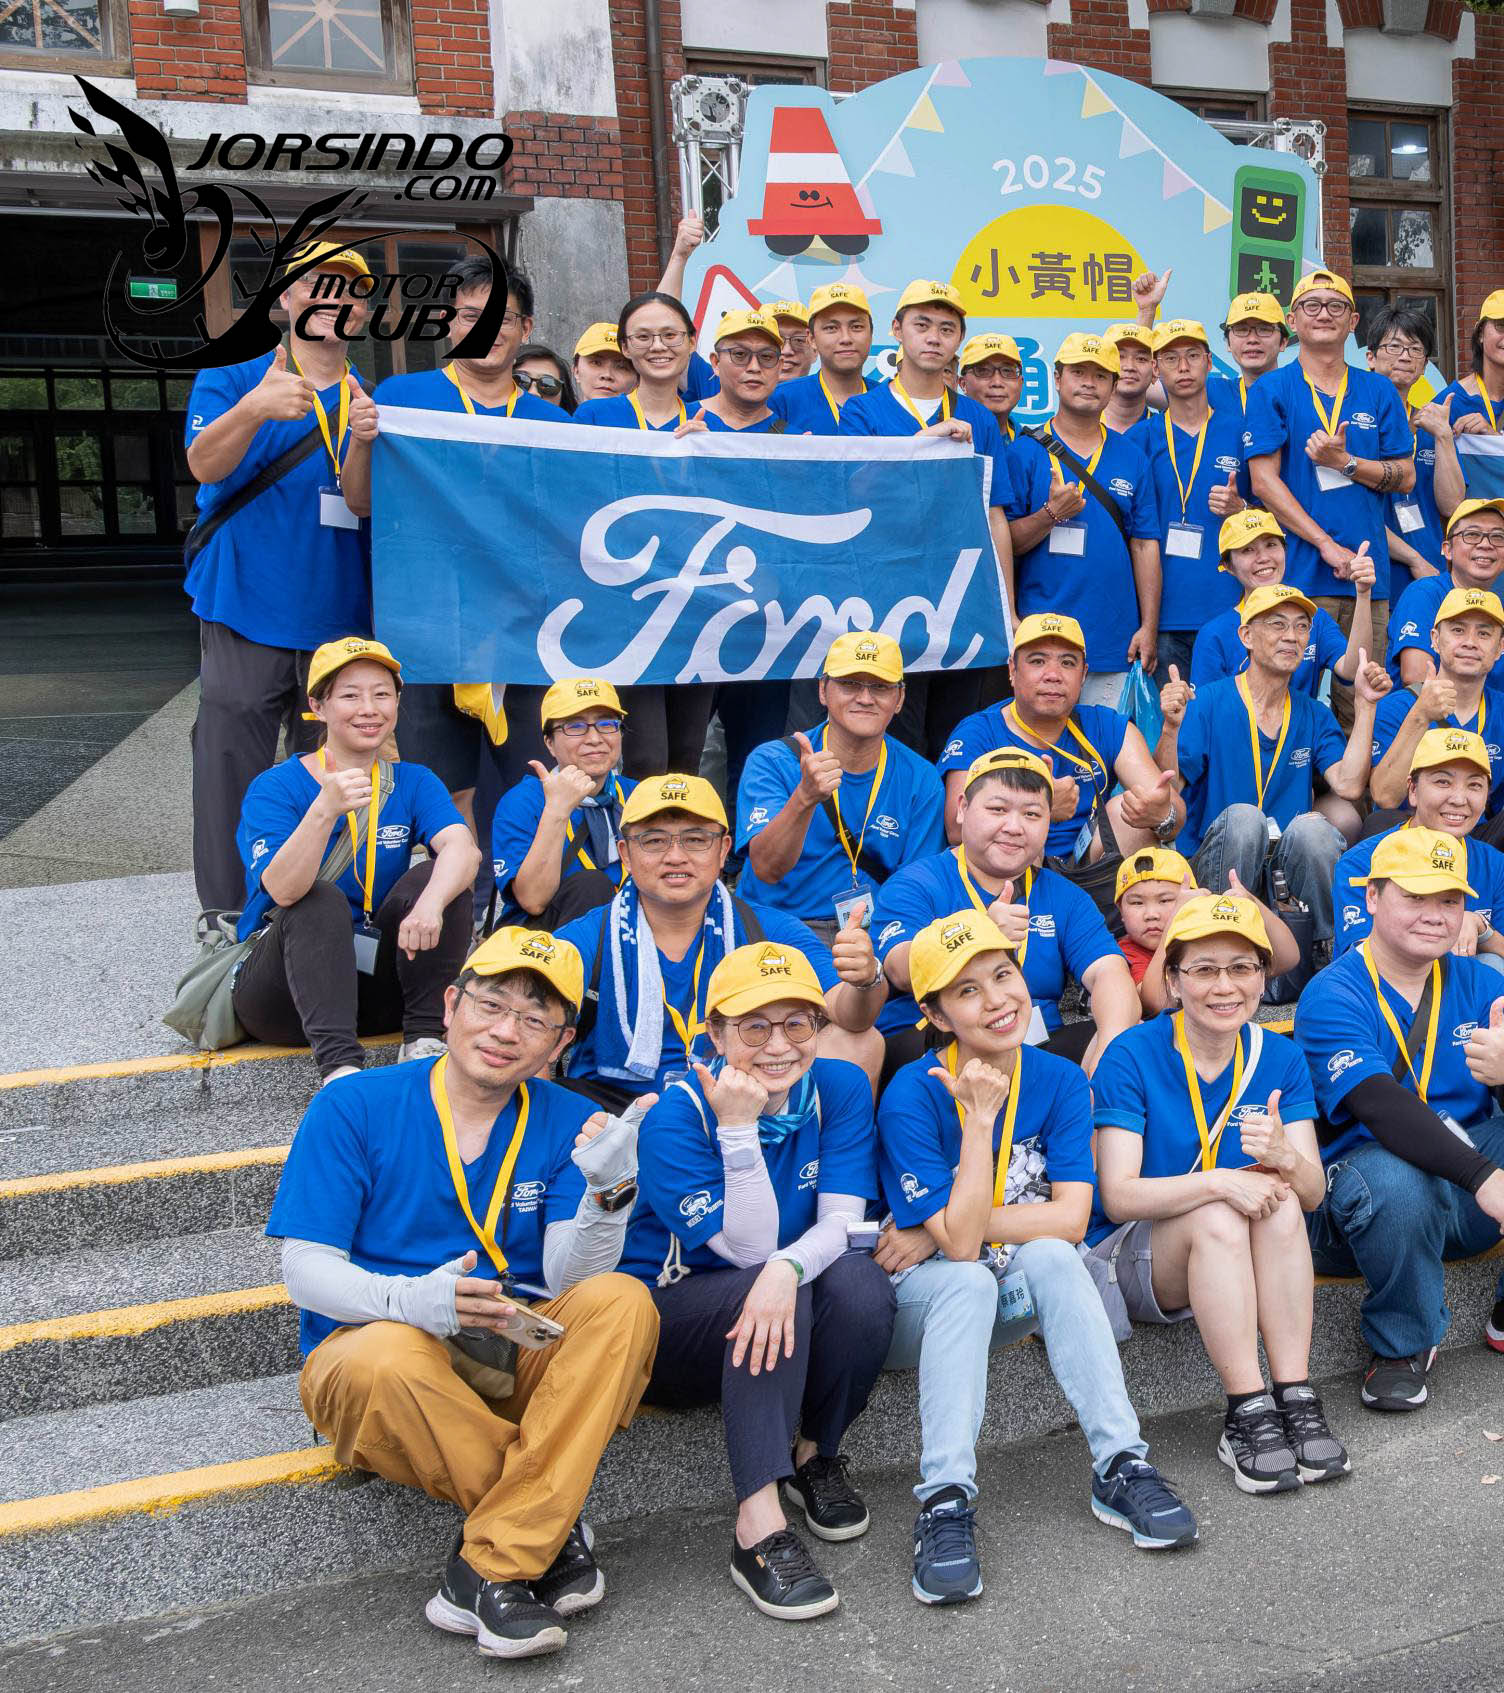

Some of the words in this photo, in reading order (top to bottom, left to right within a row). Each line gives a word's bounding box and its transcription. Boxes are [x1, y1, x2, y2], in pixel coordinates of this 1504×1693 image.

[991, 154, 1106, 199] 2025
[970, 248, 1133, 302] 小黃帽
[931, 288, 948, 296] SAFE
[747, 318, 765, 326] SAFE
[1082, 346, 1100, 354] SAFE
[1245, 522, 1264, 530] SAFE
[537, 494, 984, 685] Ford
[855, 653, 878, 662] SAFE
[1446, 743, 1469, 751] SAFE
[660, 792, 687, 801] SAFE
[381, 827, 404, 839] Ford
[1432, 859, 1455, 872] SAFE
[1212, 913, 1240, 923] SAFE
[946, 931, 975, 953] SAFE
[519, 947, 552, 965] SAFE
[760, 967, 792, 977] SAFE
[514, 1183, 539, 1198] For
